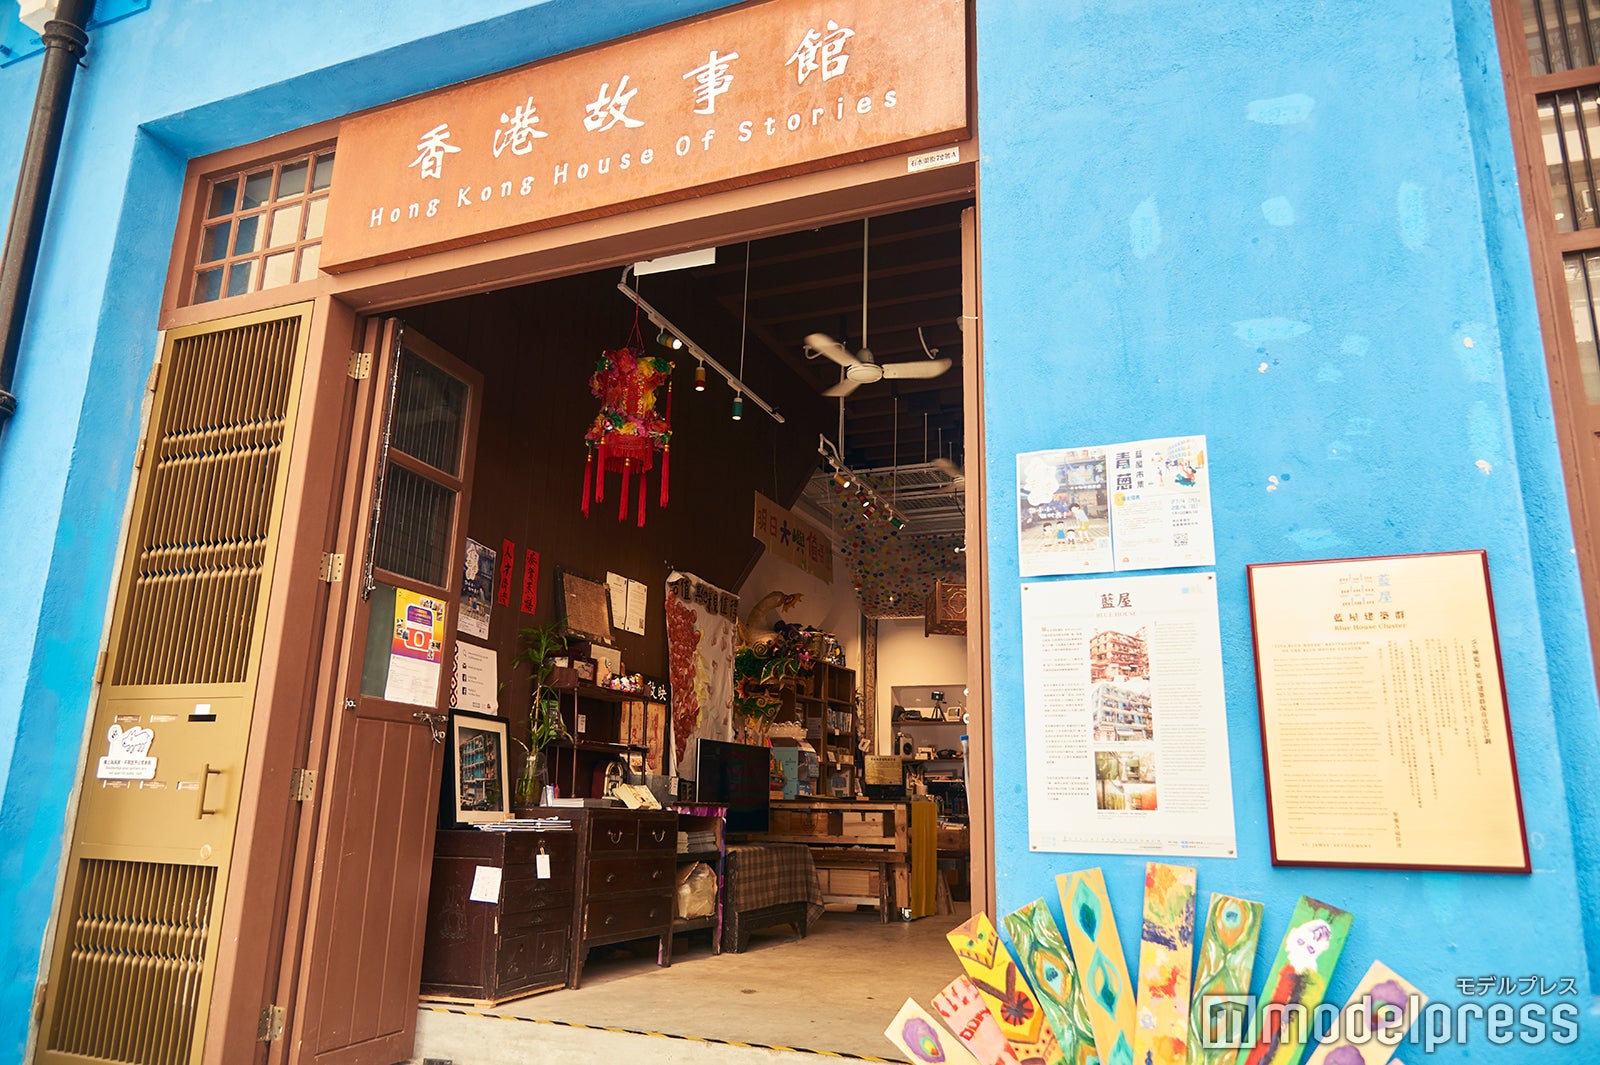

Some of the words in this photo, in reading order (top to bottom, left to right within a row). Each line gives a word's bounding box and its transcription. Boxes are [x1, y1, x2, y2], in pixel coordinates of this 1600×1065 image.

[370, 198, 440, 227] Hong
[457, 176, 535, 207] Kong
[554, 148, 654, 185] House
[675, 129, 715, 156] Of
[738, 90, 897, 142] Stories
[408, 20, 856, 179] 香港故事館
[1100, 592, 1133, 609] 藍屋
